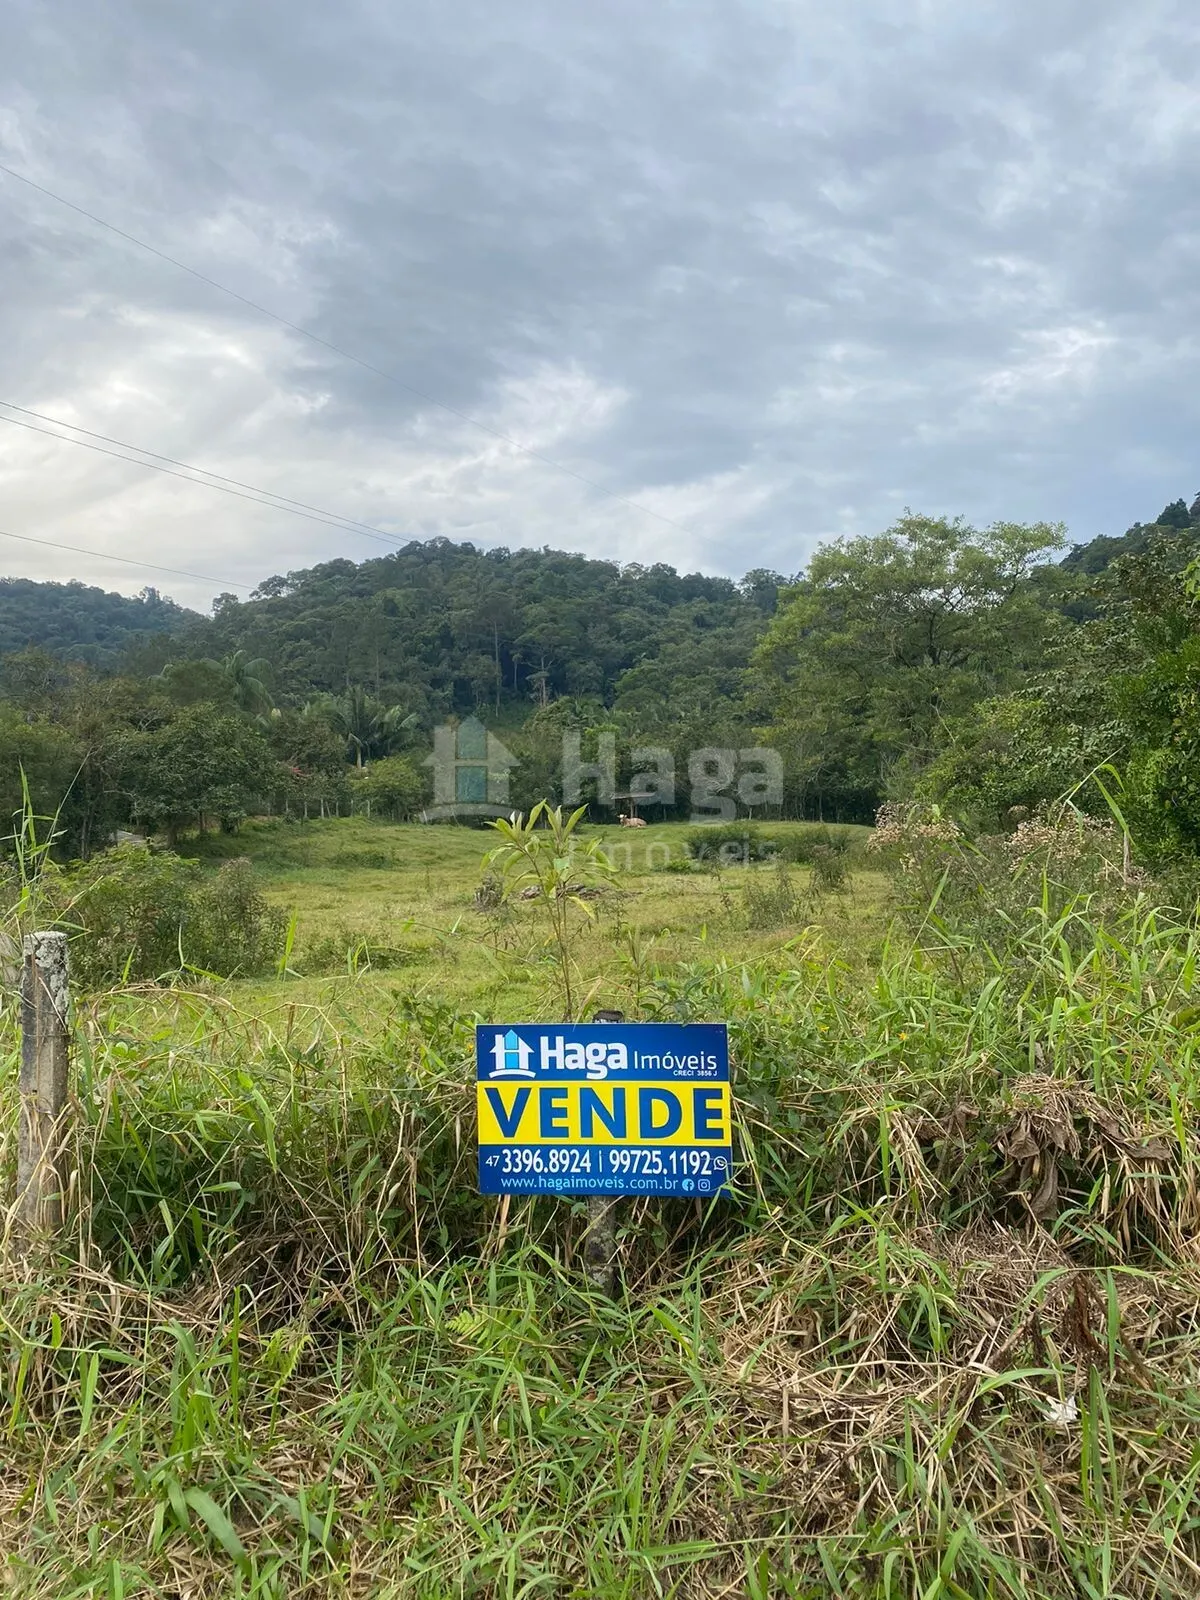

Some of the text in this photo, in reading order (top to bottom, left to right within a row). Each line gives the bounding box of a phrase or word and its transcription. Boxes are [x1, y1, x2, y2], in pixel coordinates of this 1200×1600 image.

[540, 1036, 717, 1080] Haga Imóveis
[673, 1069, 694, 1077] CRECI
[484, 1087, 725, 1140] VENDE
[485, 1156, 500, 1167] 47
[502, 1149, 592, 1173] 3396.8924
[609, 1150, 712, 1175] 99725.1192
[500, 1176, 679, 1192] www.hagaimoveis.com.br
